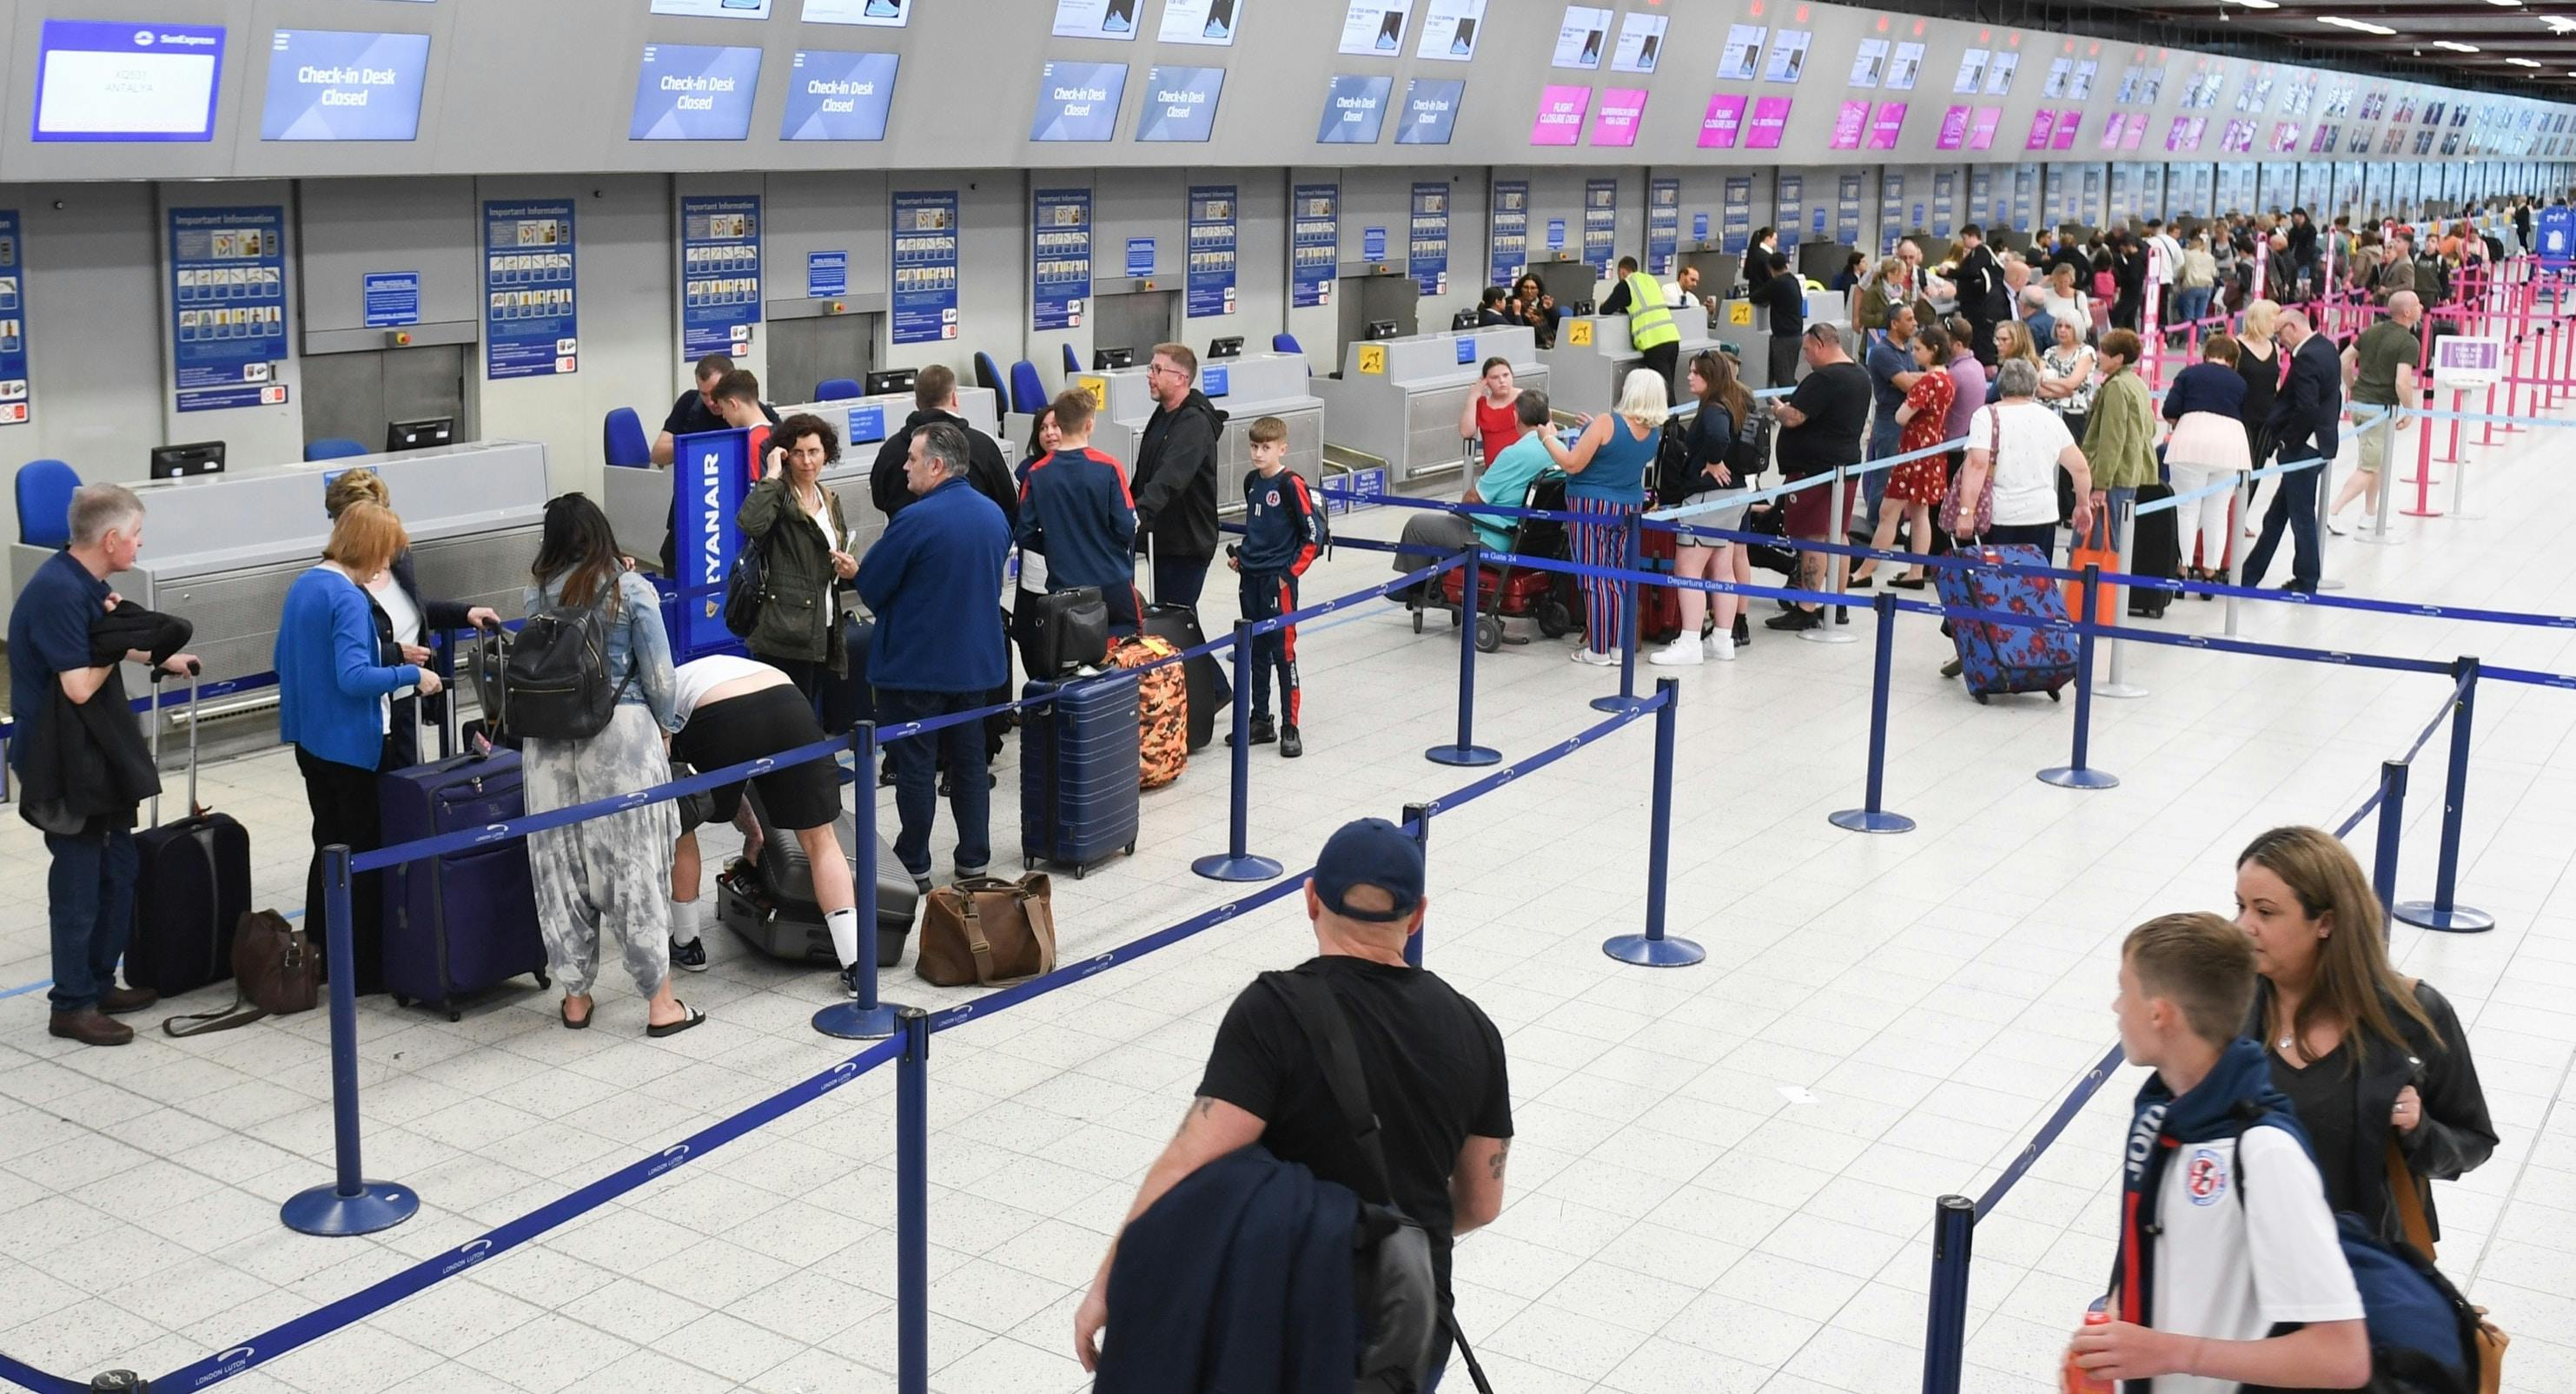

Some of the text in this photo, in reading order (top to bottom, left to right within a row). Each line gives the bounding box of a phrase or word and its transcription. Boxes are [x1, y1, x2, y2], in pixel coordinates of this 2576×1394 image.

[160, 34, 215, 46] SunExpress
[298, 66, 396, 85] Check-in Desk
[660, 76, 735, 91] Check-in Desk
[807, 80, 874, 96] Check-in Desk
[321, 89, 368, 106] Closed
[1054, 87, 1108, 102] Check-in Desk
[1157, 90, 1206, 104] Check-in Desk
[677, 96, 712, 109] Closed
[822, 98, 854, 113] Closed
[1336, 96, 1376, 109] Check-in Desk
[1413, 99, 1449, 111] Check-in Desk
[1553, 102, 1574, 113] FLIGHT
[1064, 103, 1091, 116] Closed
[1167, 106, 1190, 118] Closed
[1343, 111, 1363, 122] Closed
[1418, 113, 1437, 124] Closed
[1540, 113, 1580, 124] CLOSURE DESK
[685, 201, 754, 212] Important Information
[924, 196, 953, 205] Information
[489, 206, 568, 217] Important Information
[175, 214, 275, 226] Important Information
[1255, 503, 1262, 517] 11
[704, 453, 721, 597] RYANAIR
[1490, 552, 1507, 562] Gate
[1507, 554, 1517, 563] 24
[1667, 576, 1734, 591] Departure Gate 24
[820, 1078, 838, 1091] LONDON
[647, 1154, 684, 1176] LONDON LUTON
[442, 1249, 486, 1274] LONDON LUTON
[195, 1358, 247, 1386] LONDON LUTON
